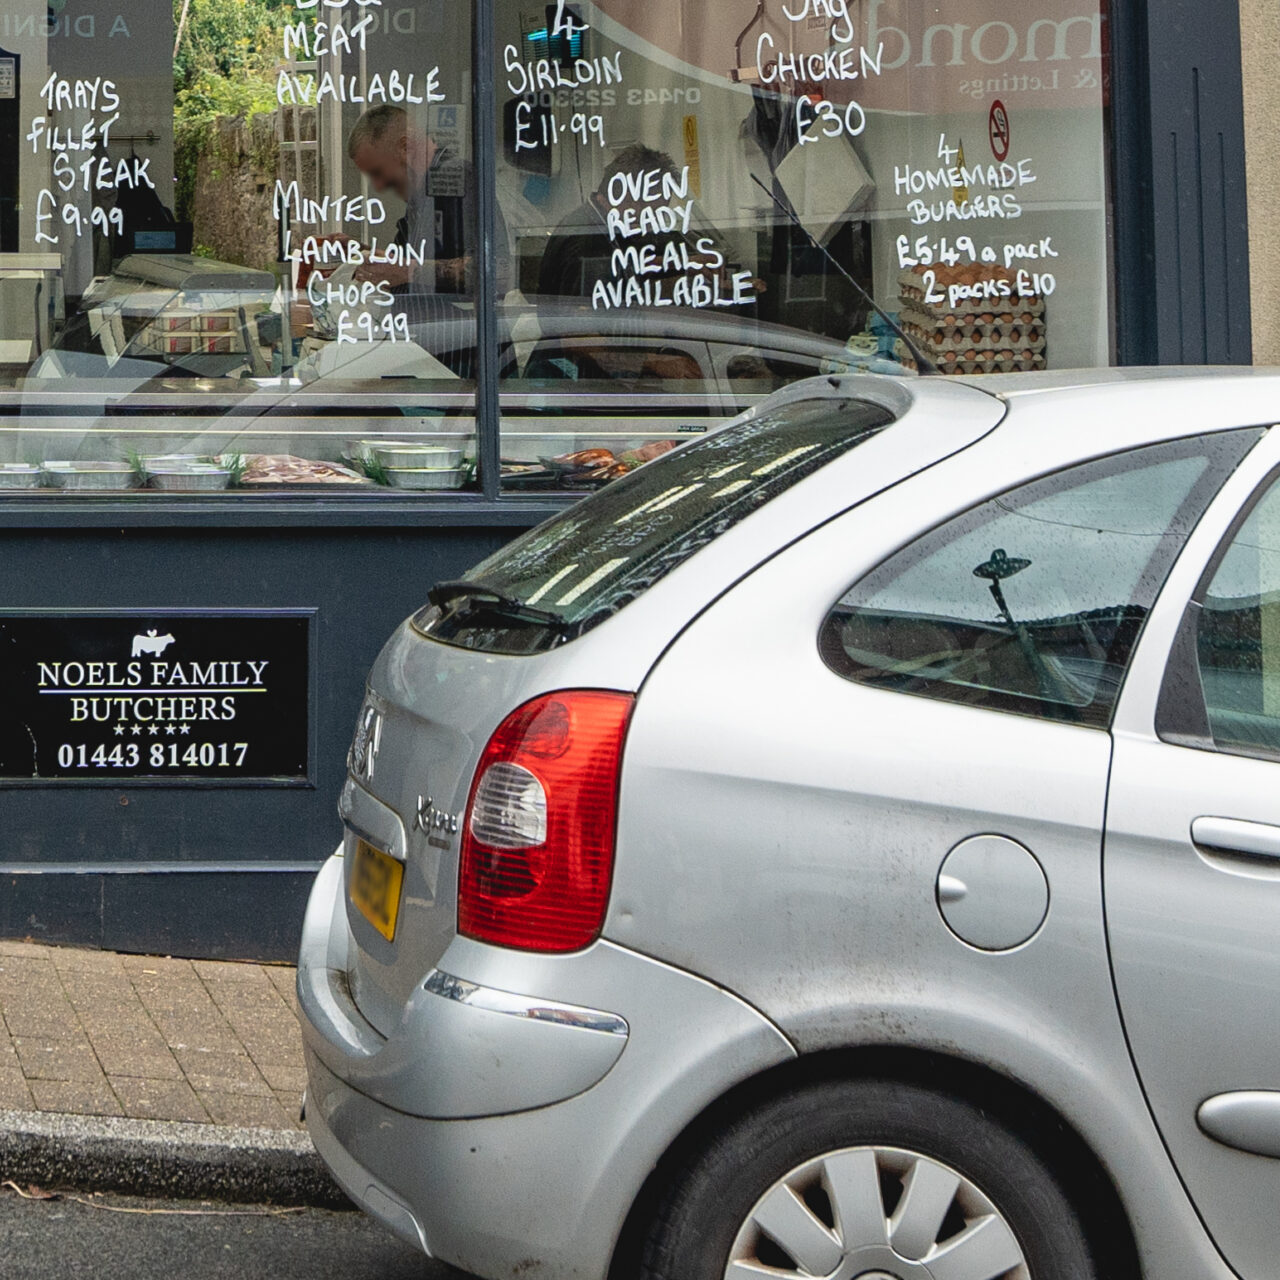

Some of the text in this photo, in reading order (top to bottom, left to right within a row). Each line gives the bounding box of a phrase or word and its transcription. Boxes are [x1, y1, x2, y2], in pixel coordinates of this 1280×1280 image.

[283, 14, 374, 59] MEAT
[503, 44, 624, 95] SIRLOIN
[755, 32, 884, 85] CHICKEN
[39, 71, 120, 112] TRAYS
[276, 66, 446, 105] AVAILABLE
[26, 111, 120, 154] FILLET
[513, 101, 606, 153] £11.99
[795, 94, 866, 146] £30
[937, 132, 959, 165] 4
[53, 152, 156, 192] STEAK
[606, 165, 690, 206] OVEN
[894, 157, 1037, 196] HOMEMADE
[34, 188, 124, 244] £9.99
[272, 179, 386, 225] MINTED
[606, 200, 694, 242] READY
[283, 230, 427, 267] LAMB LOIN
[611, 238, 724, 277] MEALS
[896, 234, 1058, 269] £5.49 a pack
[307, 270, 395, 307] CHOPS
[591, 271, 757, 310] AVAILABLE
[923, 270, 1057, 308] 2 packs £10
[337, 309, 410, 345] £9.99
[37, 661, 269, 686] NOELS FAMILY
[70, 696, 236, 721] BUTCHERS
[58, 742, 248, 768] 01443 814017
